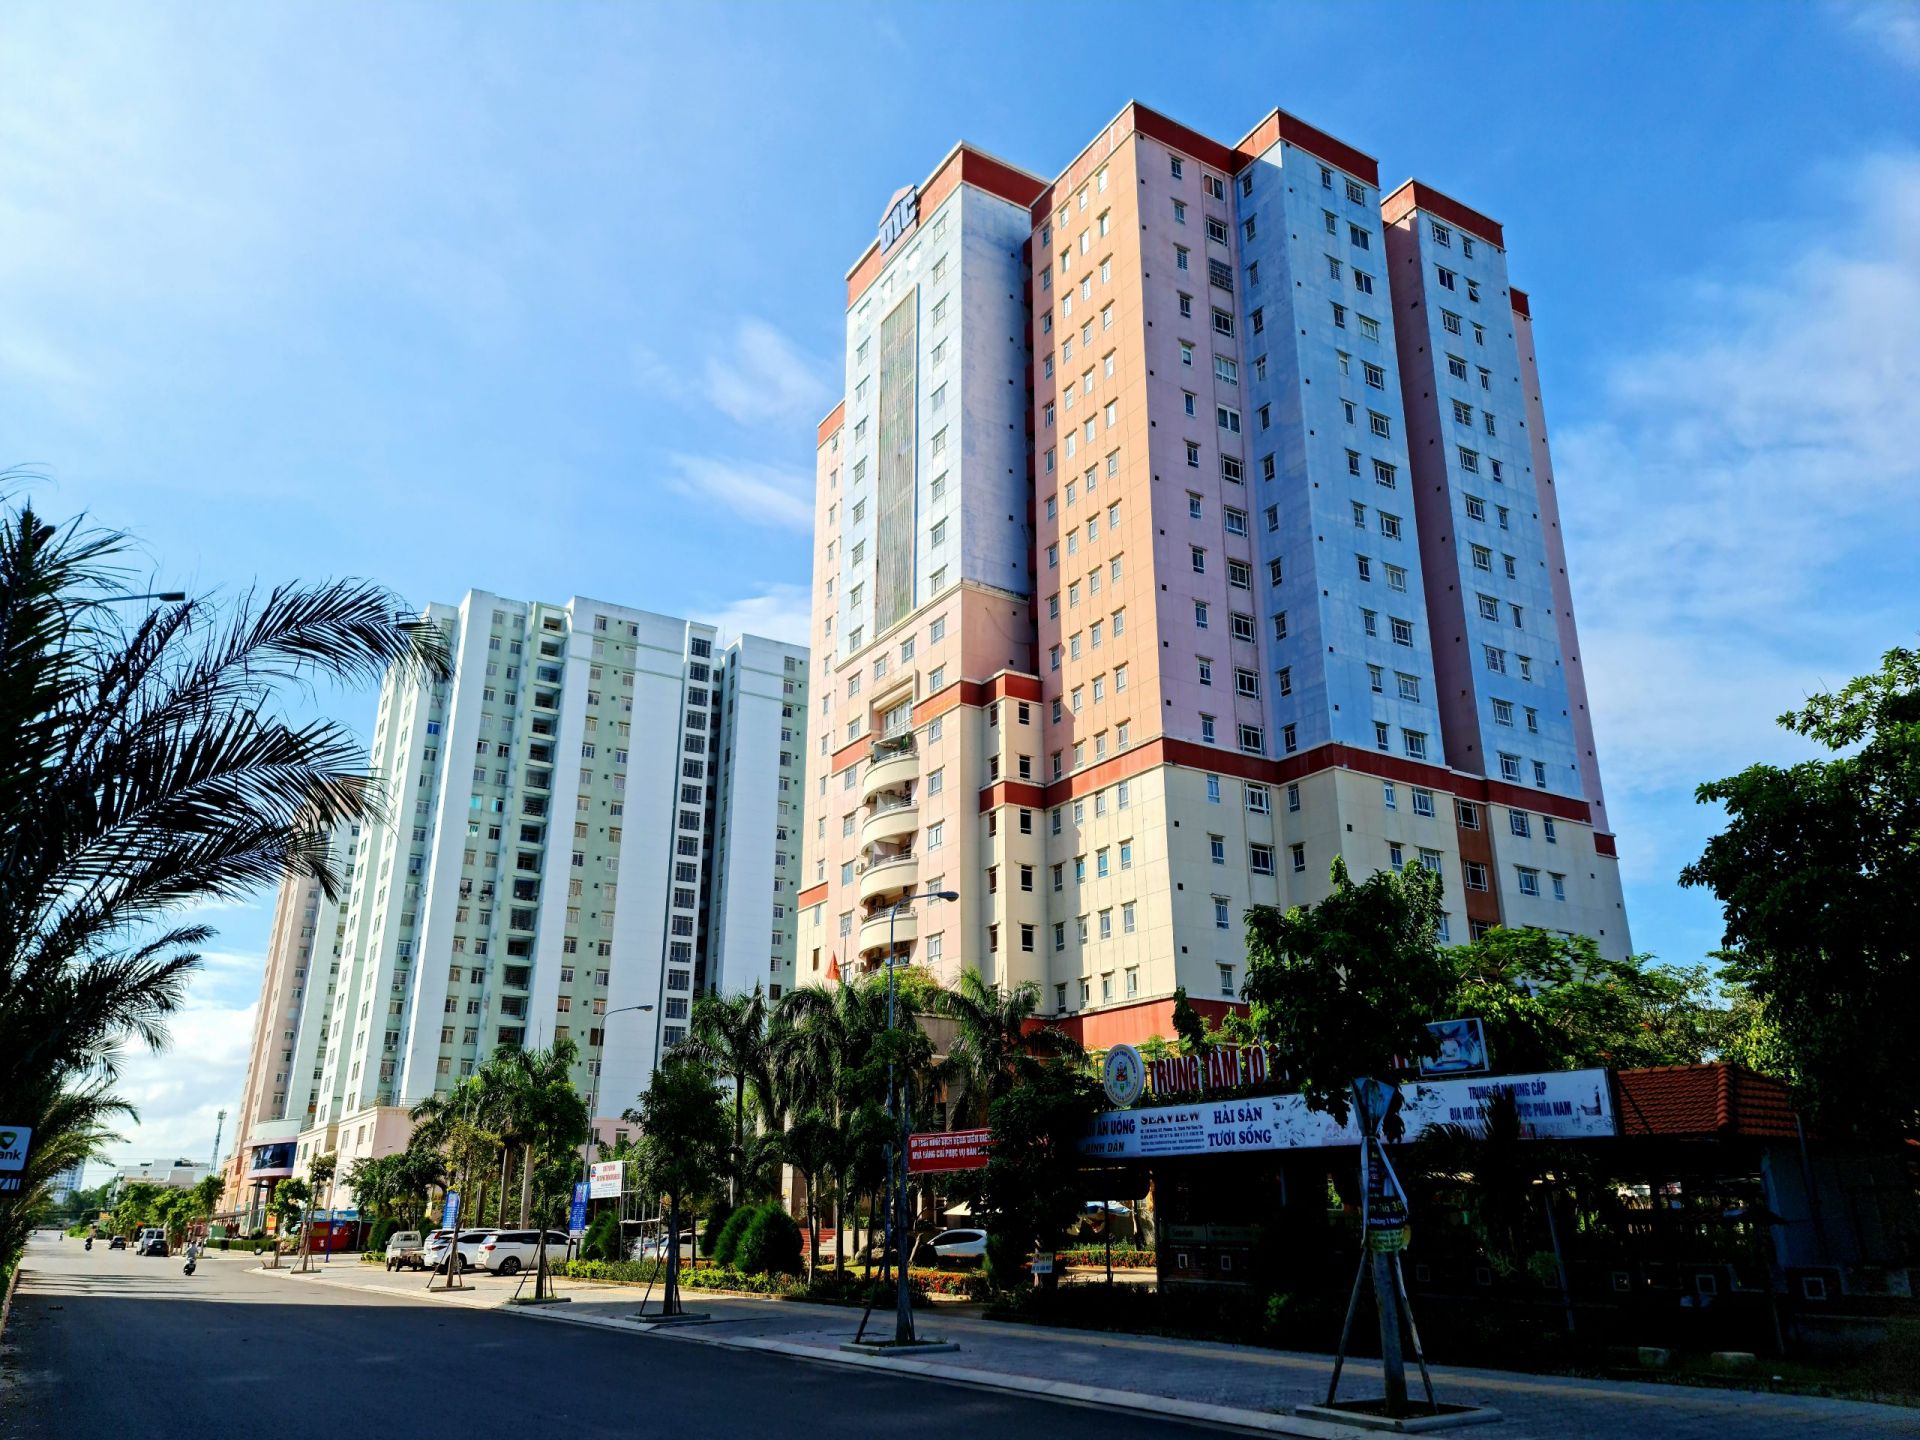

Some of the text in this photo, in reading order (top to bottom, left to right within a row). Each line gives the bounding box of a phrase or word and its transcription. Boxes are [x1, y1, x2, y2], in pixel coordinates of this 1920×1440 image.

[1148, 1054, 1201, 1094] TRUNG
[1213, 1102, 1262, 1124] HẢI SẢN
[1449, 1107, 1461, 1120] BIA
[1553, 1101, 1572, 1116] NAM
[1110, 1113, 1136, 1135] UỐNG
[1208, 1130, 1236, 1147] TƯƠI
[1239, 1124, 1272, 1144] SỐNG
